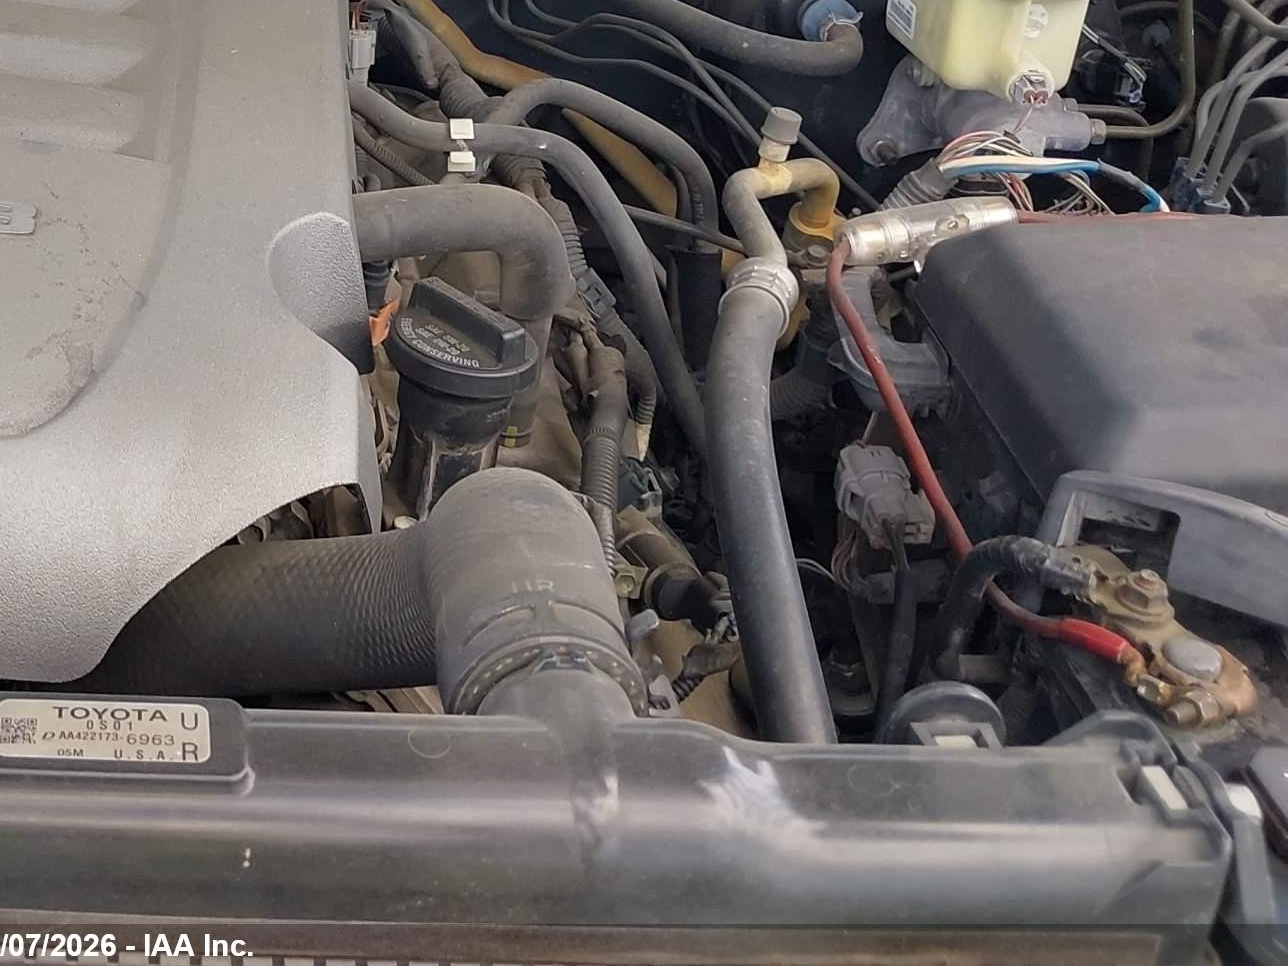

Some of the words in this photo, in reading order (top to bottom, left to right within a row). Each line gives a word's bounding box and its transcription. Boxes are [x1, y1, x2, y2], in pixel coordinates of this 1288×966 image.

[53, 706, 168, 722] TOYOTA
[181, 712, 199, 731] U
[182, 742, 199, 761] R
